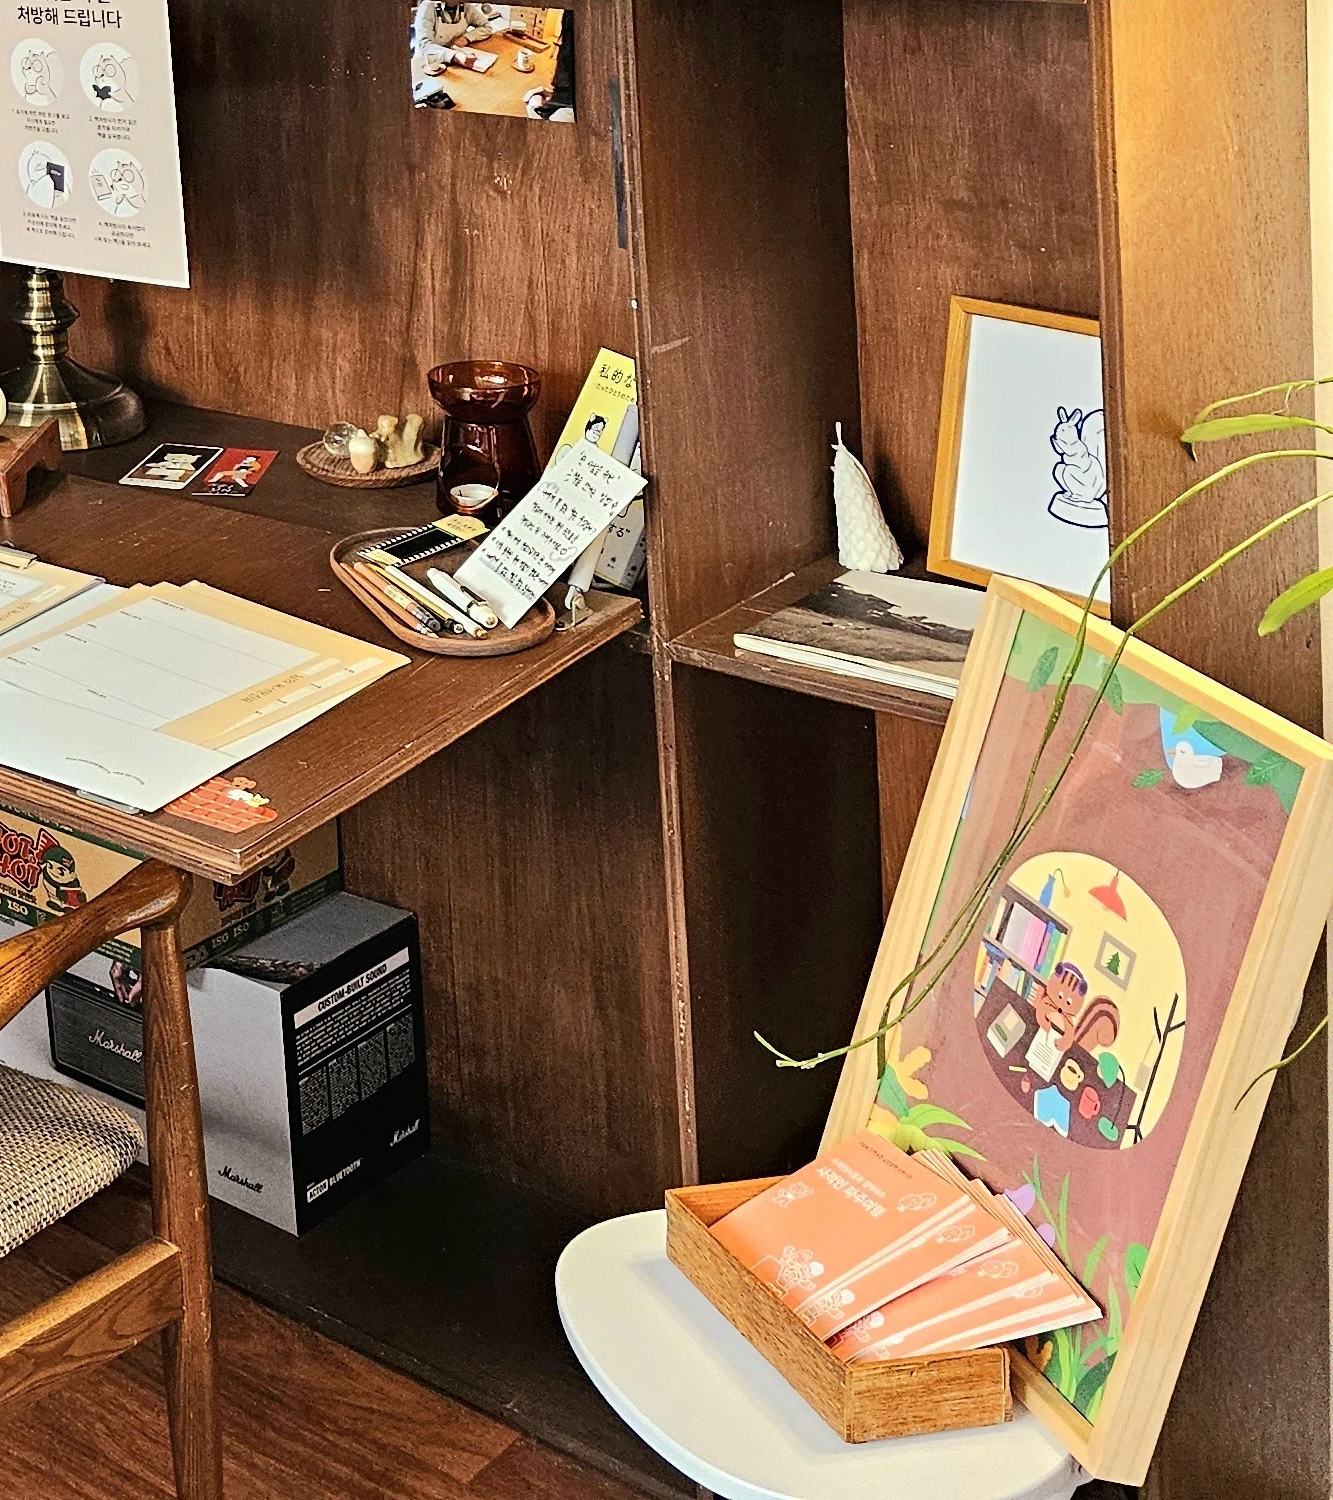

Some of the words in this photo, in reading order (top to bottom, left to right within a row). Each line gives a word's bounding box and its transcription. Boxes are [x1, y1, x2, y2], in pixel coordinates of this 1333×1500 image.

[17, 5, 59, 26] 처방해
[63, 8, 123, 29] 드립니다
[7, 900, 28, 915] ISO
[212, 933, 229, 948] ISO
[233, 922, 249, 937] ISO
[89, 1030, 142, 1062] Marshall
[218, 1166, 263, 1193] Marshall
